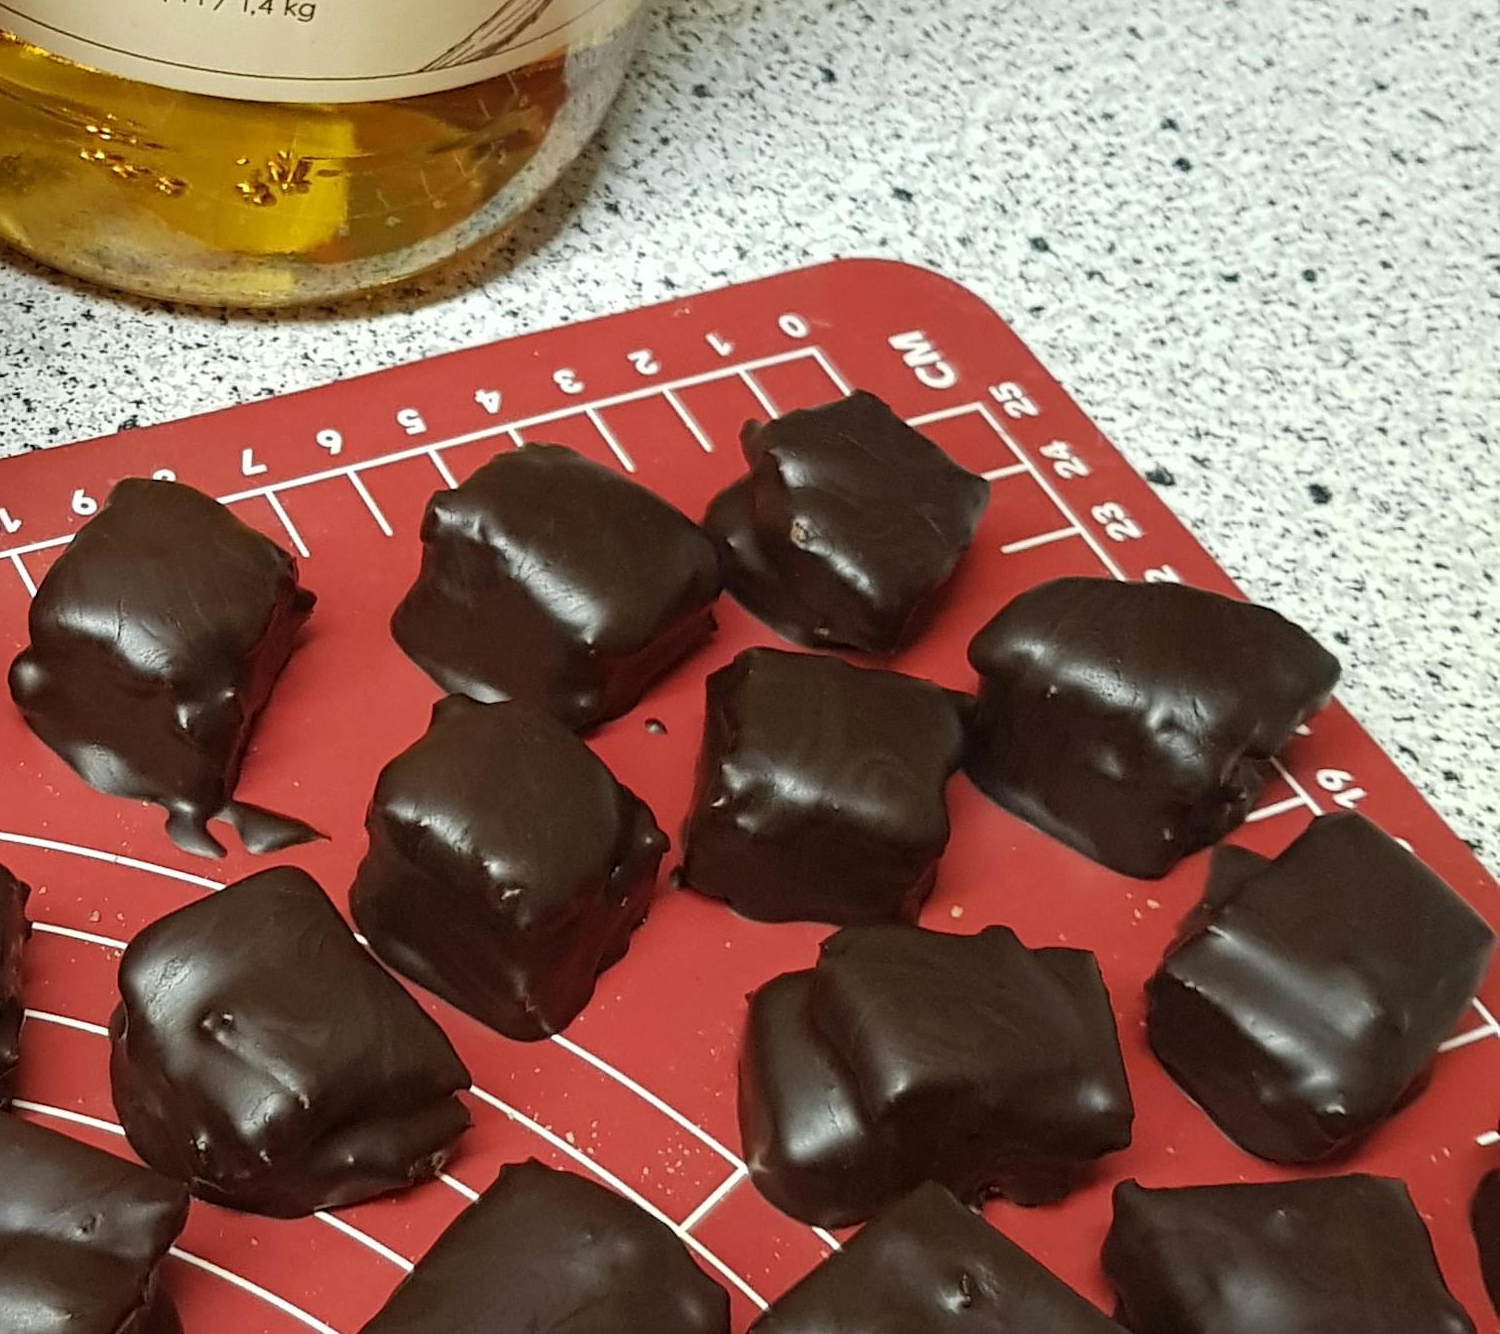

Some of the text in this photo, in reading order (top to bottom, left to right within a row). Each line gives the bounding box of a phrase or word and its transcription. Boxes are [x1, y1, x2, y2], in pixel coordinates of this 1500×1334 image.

[779, 315, 807, 337] 0
[706, 334, 732, 355] 1
[628, 350, 658, 374] 2
[889, 331, 957, 388] CM
[554, 369, 583, 393] 3
[475, 390, 500, 413] 4
[989, 382, 1038, 417] 25
[398, 409, 426, 434] 5
[317, 430, 342, 454] 6
[242, 449, 266, 475] 7
[1040, 441, 1089, 478] 24
[72, 489, 97, 515] 9
[1092, 503, 1142, 541] 23
[1316, 768, 1367, 809] 19
